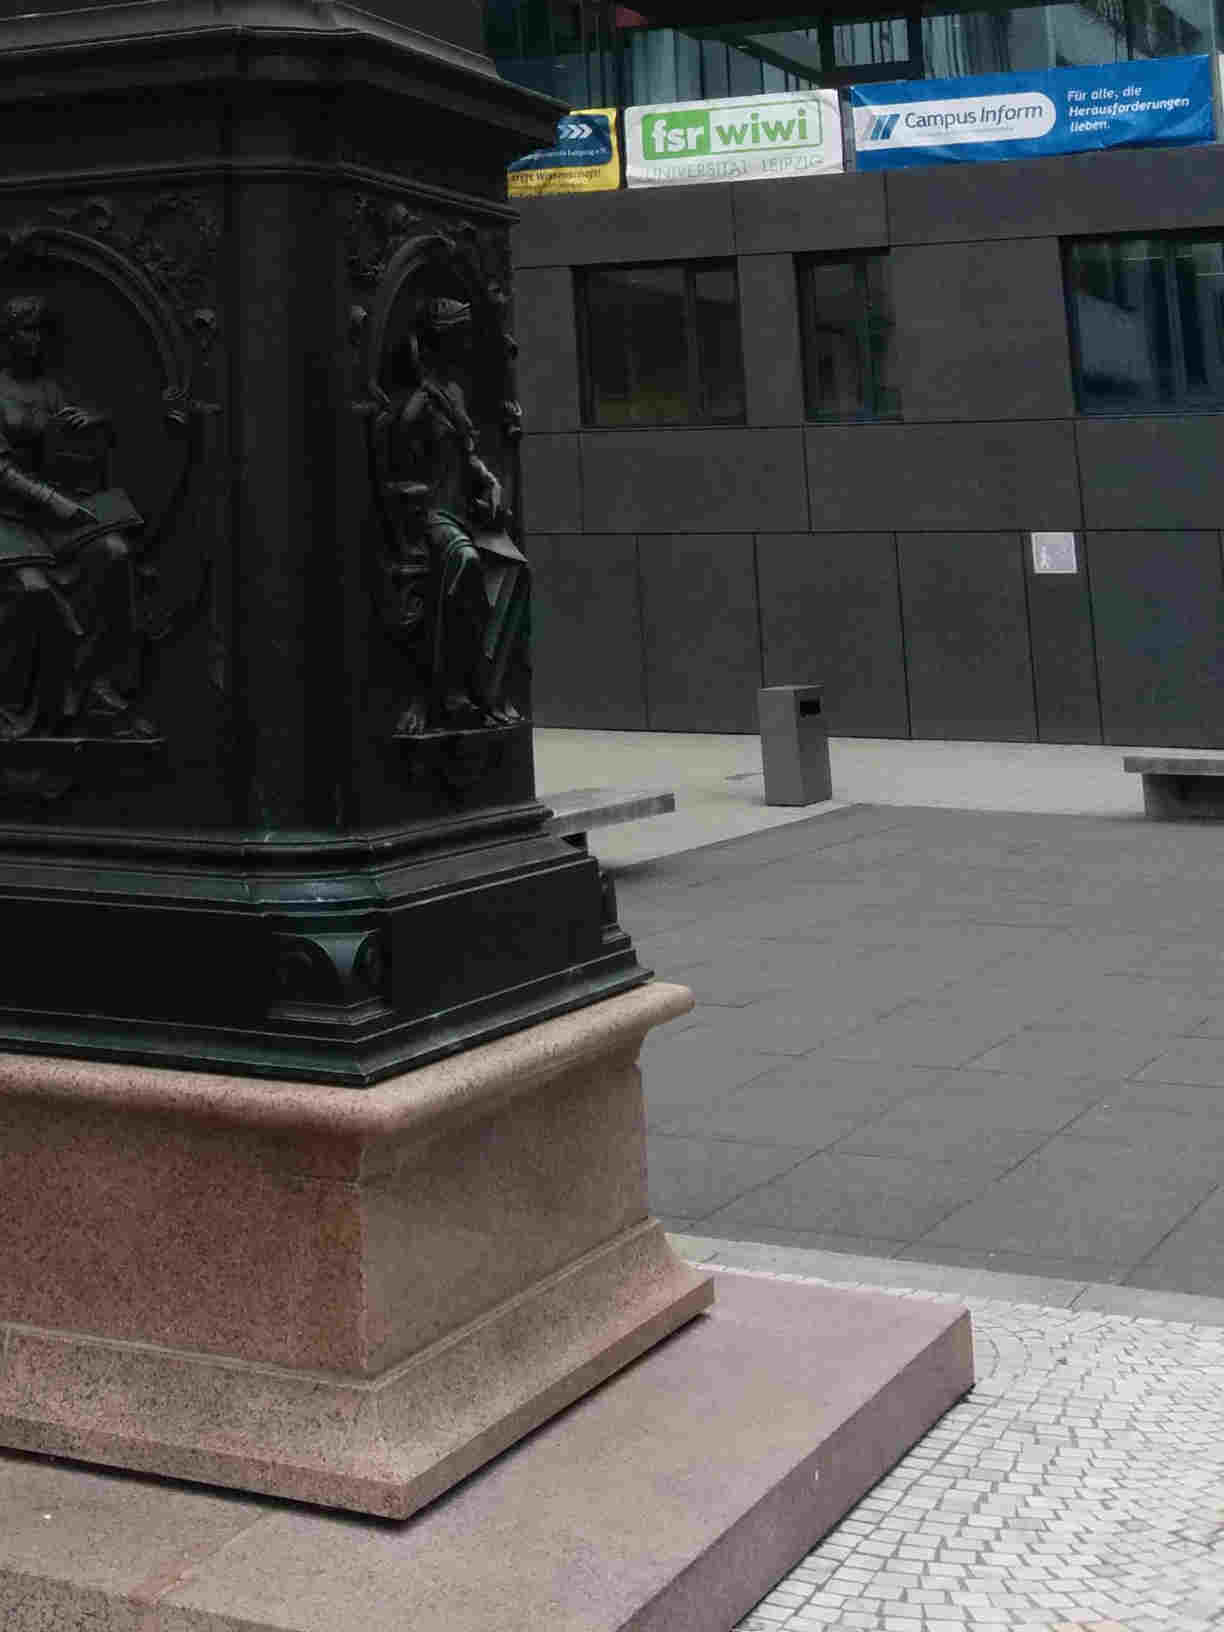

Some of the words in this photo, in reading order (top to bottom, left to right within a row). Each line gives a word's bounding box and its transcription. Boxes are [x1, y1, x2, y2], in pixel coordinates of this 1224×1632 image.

[1067, 89, 1088, 102] Für
[1123, 85, 1142, 97] die
[905, 111, 976, 129] Campus
[981, 105, 1042, 125] Inform
[1069, 98, 1190, 117] Herausforderungen
[652, 119, 704, 153] fsr
[715, 107, 808, 145] wiwi
[1071, 119, 1110, 133] lieben.
